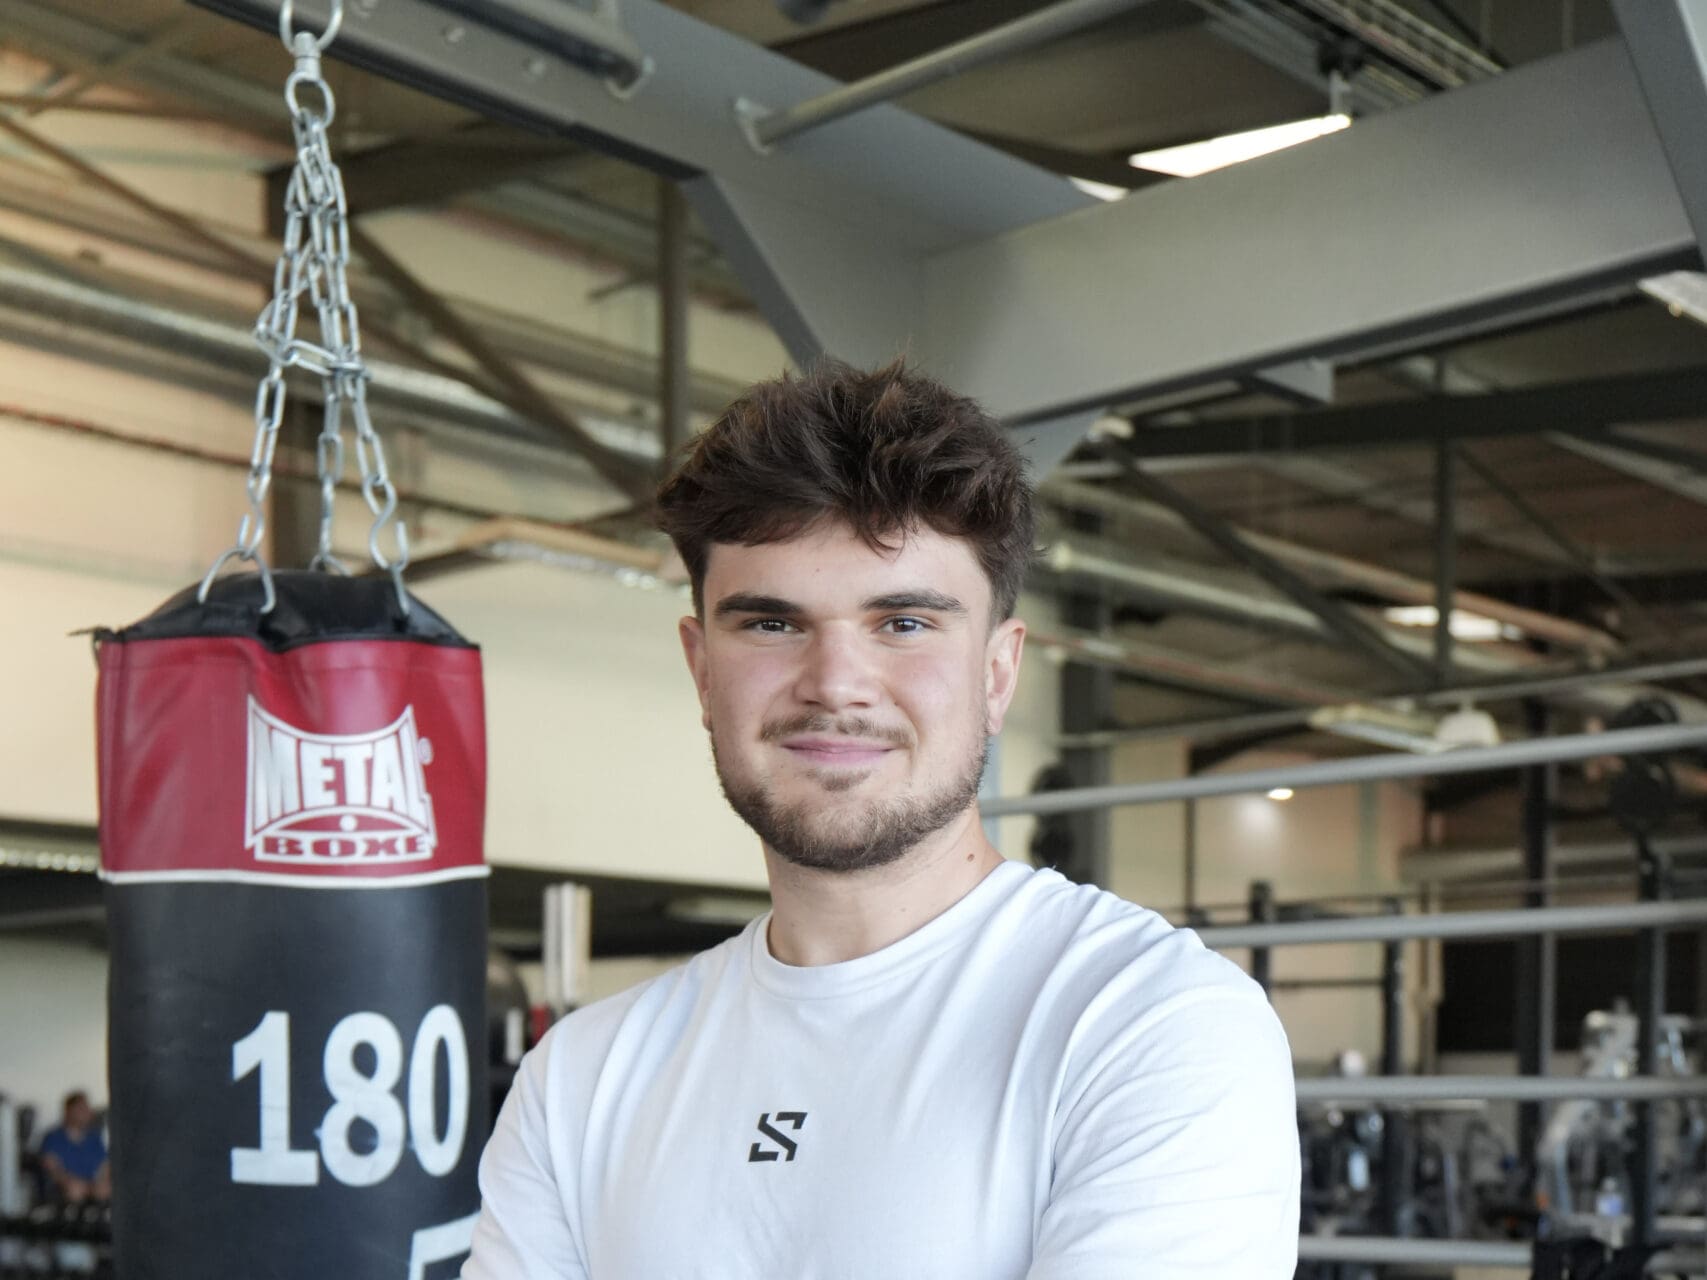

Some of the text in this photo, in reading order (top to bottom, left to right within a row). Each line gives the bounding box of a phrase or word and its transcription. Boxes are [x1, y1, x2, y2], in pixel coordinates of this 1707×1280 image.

[253, 715, 430, 831] METAL
[263, 836, 428, 858] BOXE
[230, 1004, 470, 1187] 180
